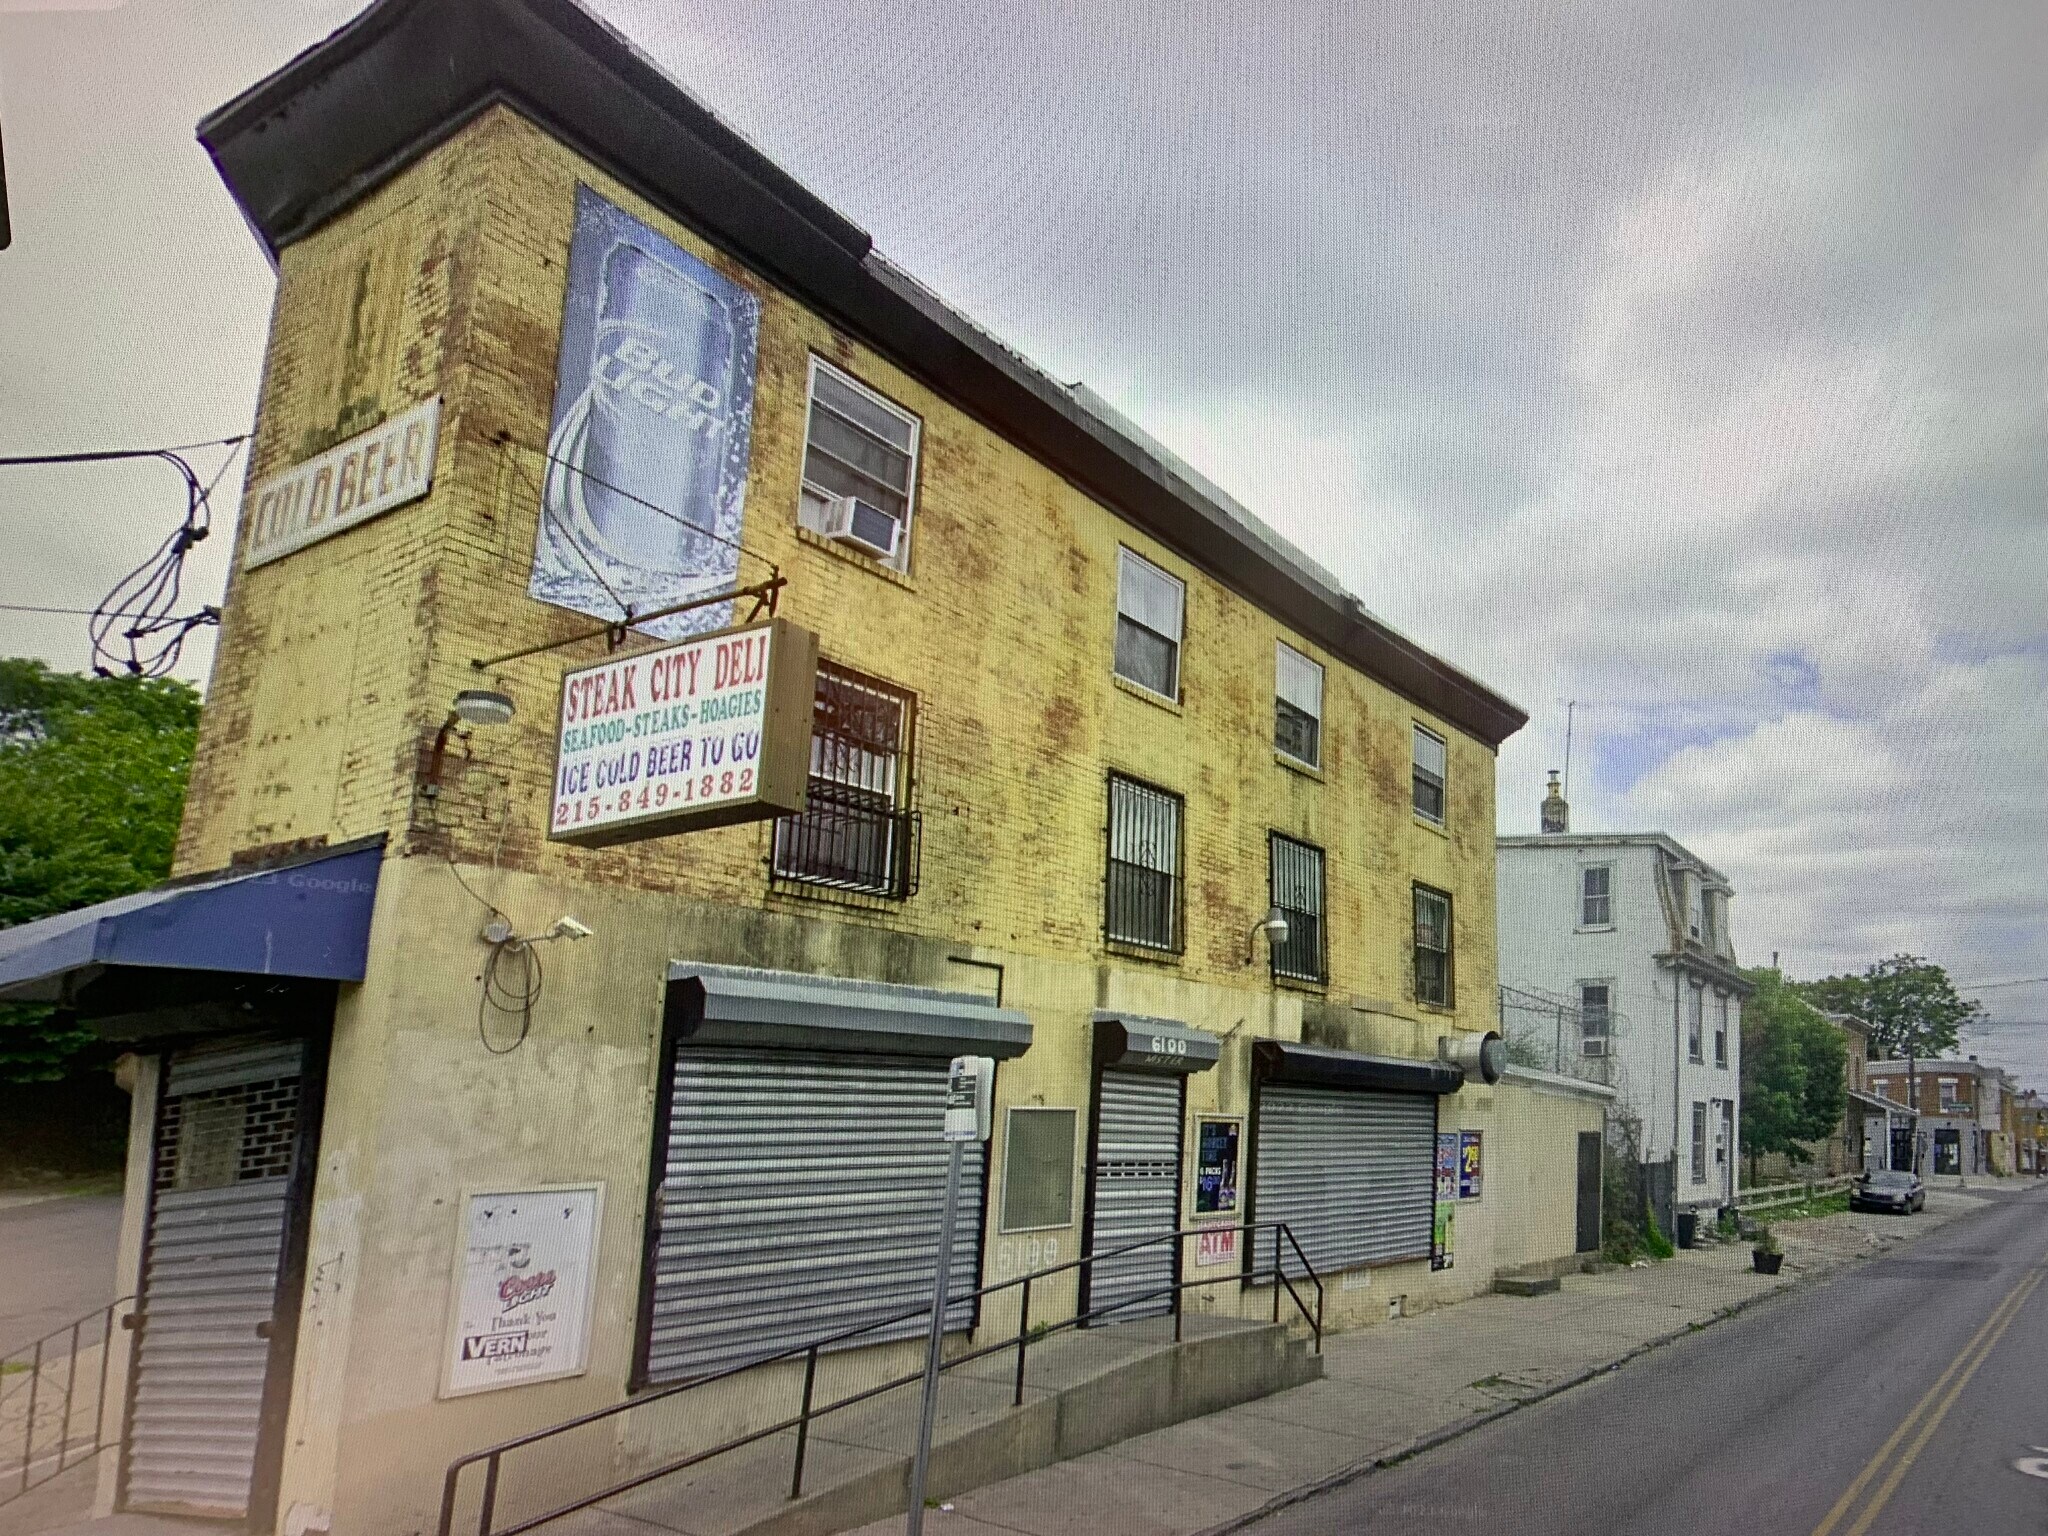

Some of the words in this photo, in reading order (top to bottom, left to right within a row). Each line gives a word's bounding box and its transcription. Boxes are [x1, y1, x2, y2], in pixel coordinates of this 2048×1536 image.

[566, 663, 638, 723] STEAK
[650, 648, 703, 703] CITY
[714, 635, 767, 690] DELI
[560, 762, 590, 796] ICE
[595, 751, 641, 790] COLD
[646, 739, 693, 778] BEER
[701, 735, 726, 768] TO
[731, 729, 760, 763] GO
[555, 767, 754, 826] 215-849-1882
[1151, 1035, 1187, 1055] 6100
[1199, 1230, 1235, 1255] ATM
[491, 1313, 531, 1331] Thank
[467, 1335, 527, 1359] VERN
